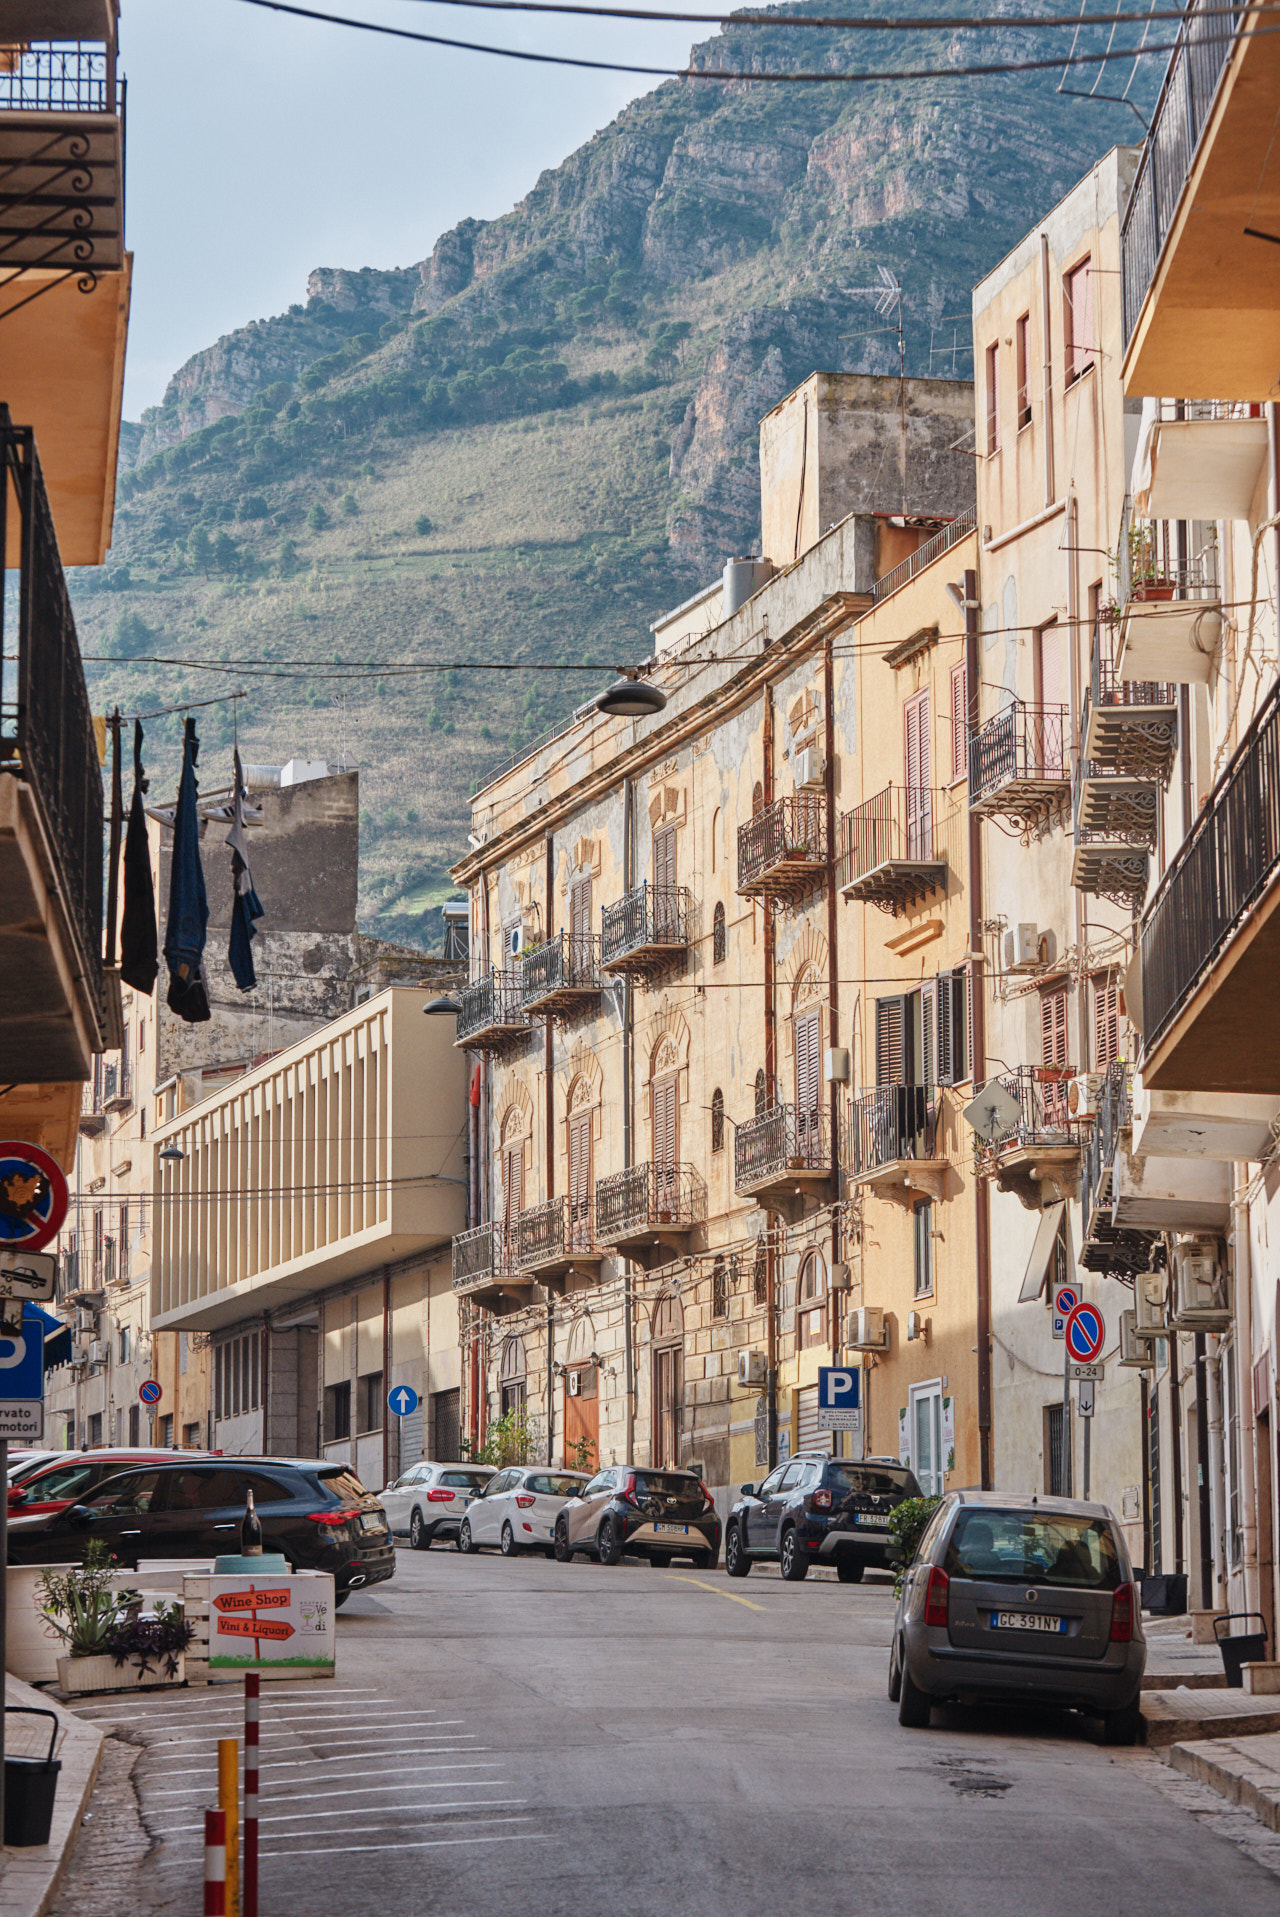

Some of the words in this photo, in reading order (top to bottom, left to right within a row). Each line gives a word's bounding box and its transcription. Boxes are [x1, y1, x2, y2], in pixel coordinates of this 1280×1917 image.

[1056, 1320, 1062, 1329] P
[1075, 1367, 1097, 1376] 0-24
[827, 1372, 853, 1405] P
[220, 1597, 252, 1608] Wine
[256, 1594, 287, 1606] Shop
[315, 1605, 327, 1614] Ve
[315, 1621, 327, 1631] di
[1000, 1613, 1015, 1627] GC
[1020, 1614, 1059, 1630] 391NY
[221, 1621, 239, 1631] Vini
[243, 1623, 249, 1632] &
[252, 1624, 289, 1635] Liquori
